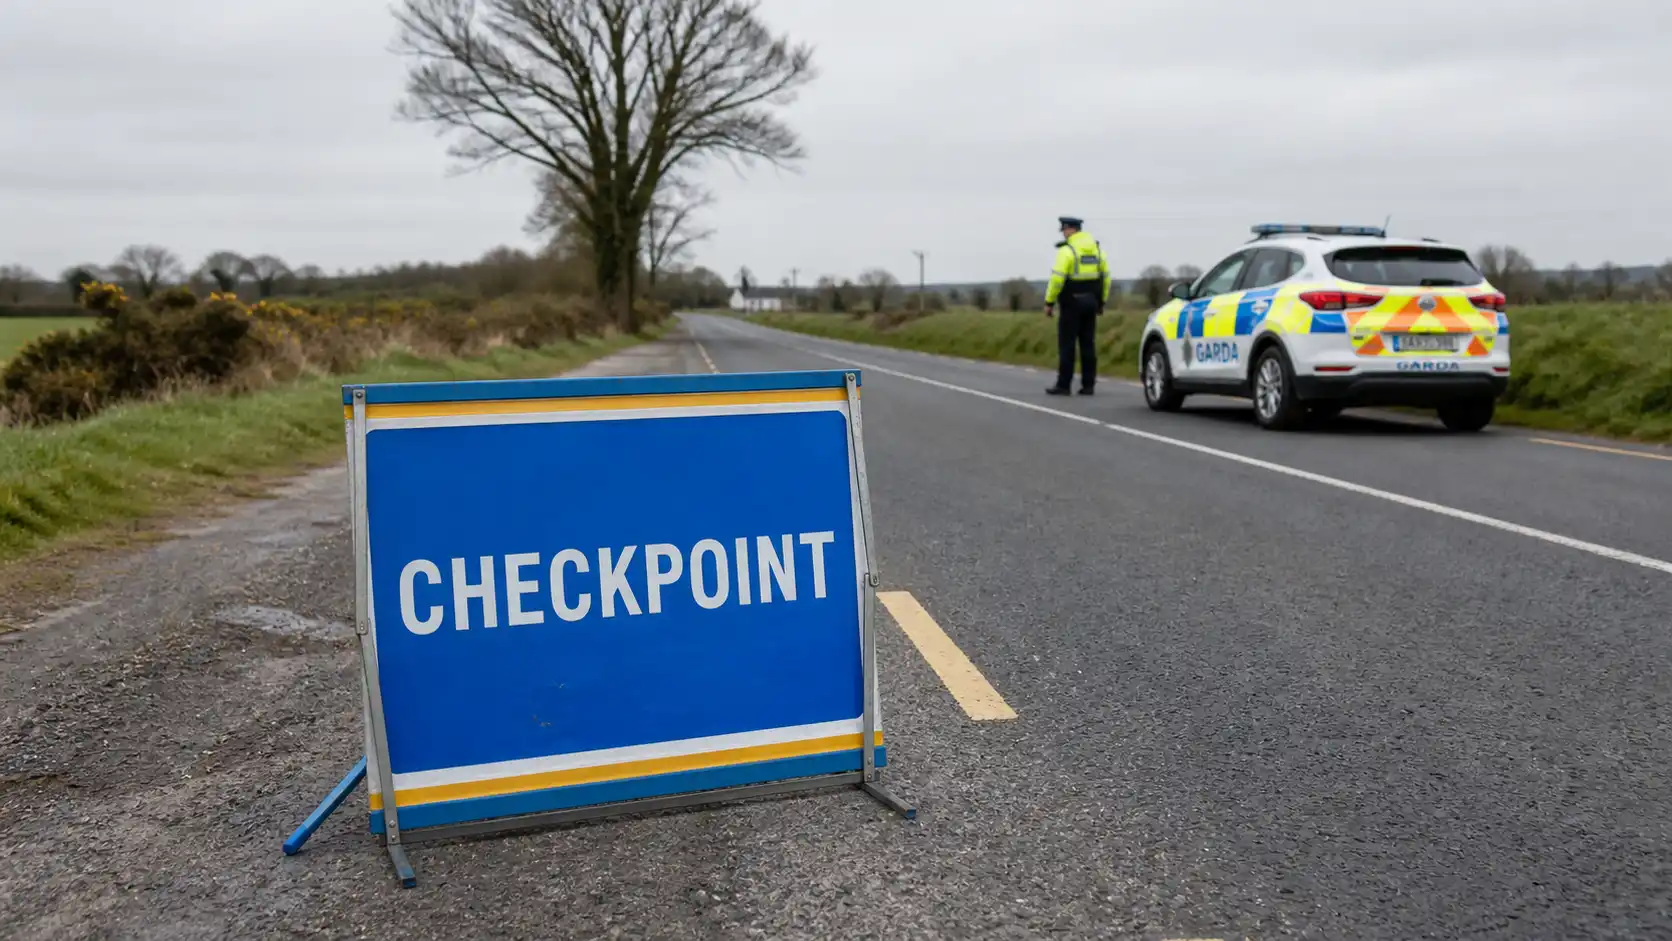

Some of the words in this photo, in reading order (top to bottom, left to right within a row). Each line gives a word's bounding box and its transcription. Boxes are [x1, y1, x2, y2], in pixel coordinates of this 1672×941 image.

[1196, 342, 1238, 363] GARDA
[1397, 361, 1460, 371] GARDA
[399, 530, 835, 636] CHECKPOINT
